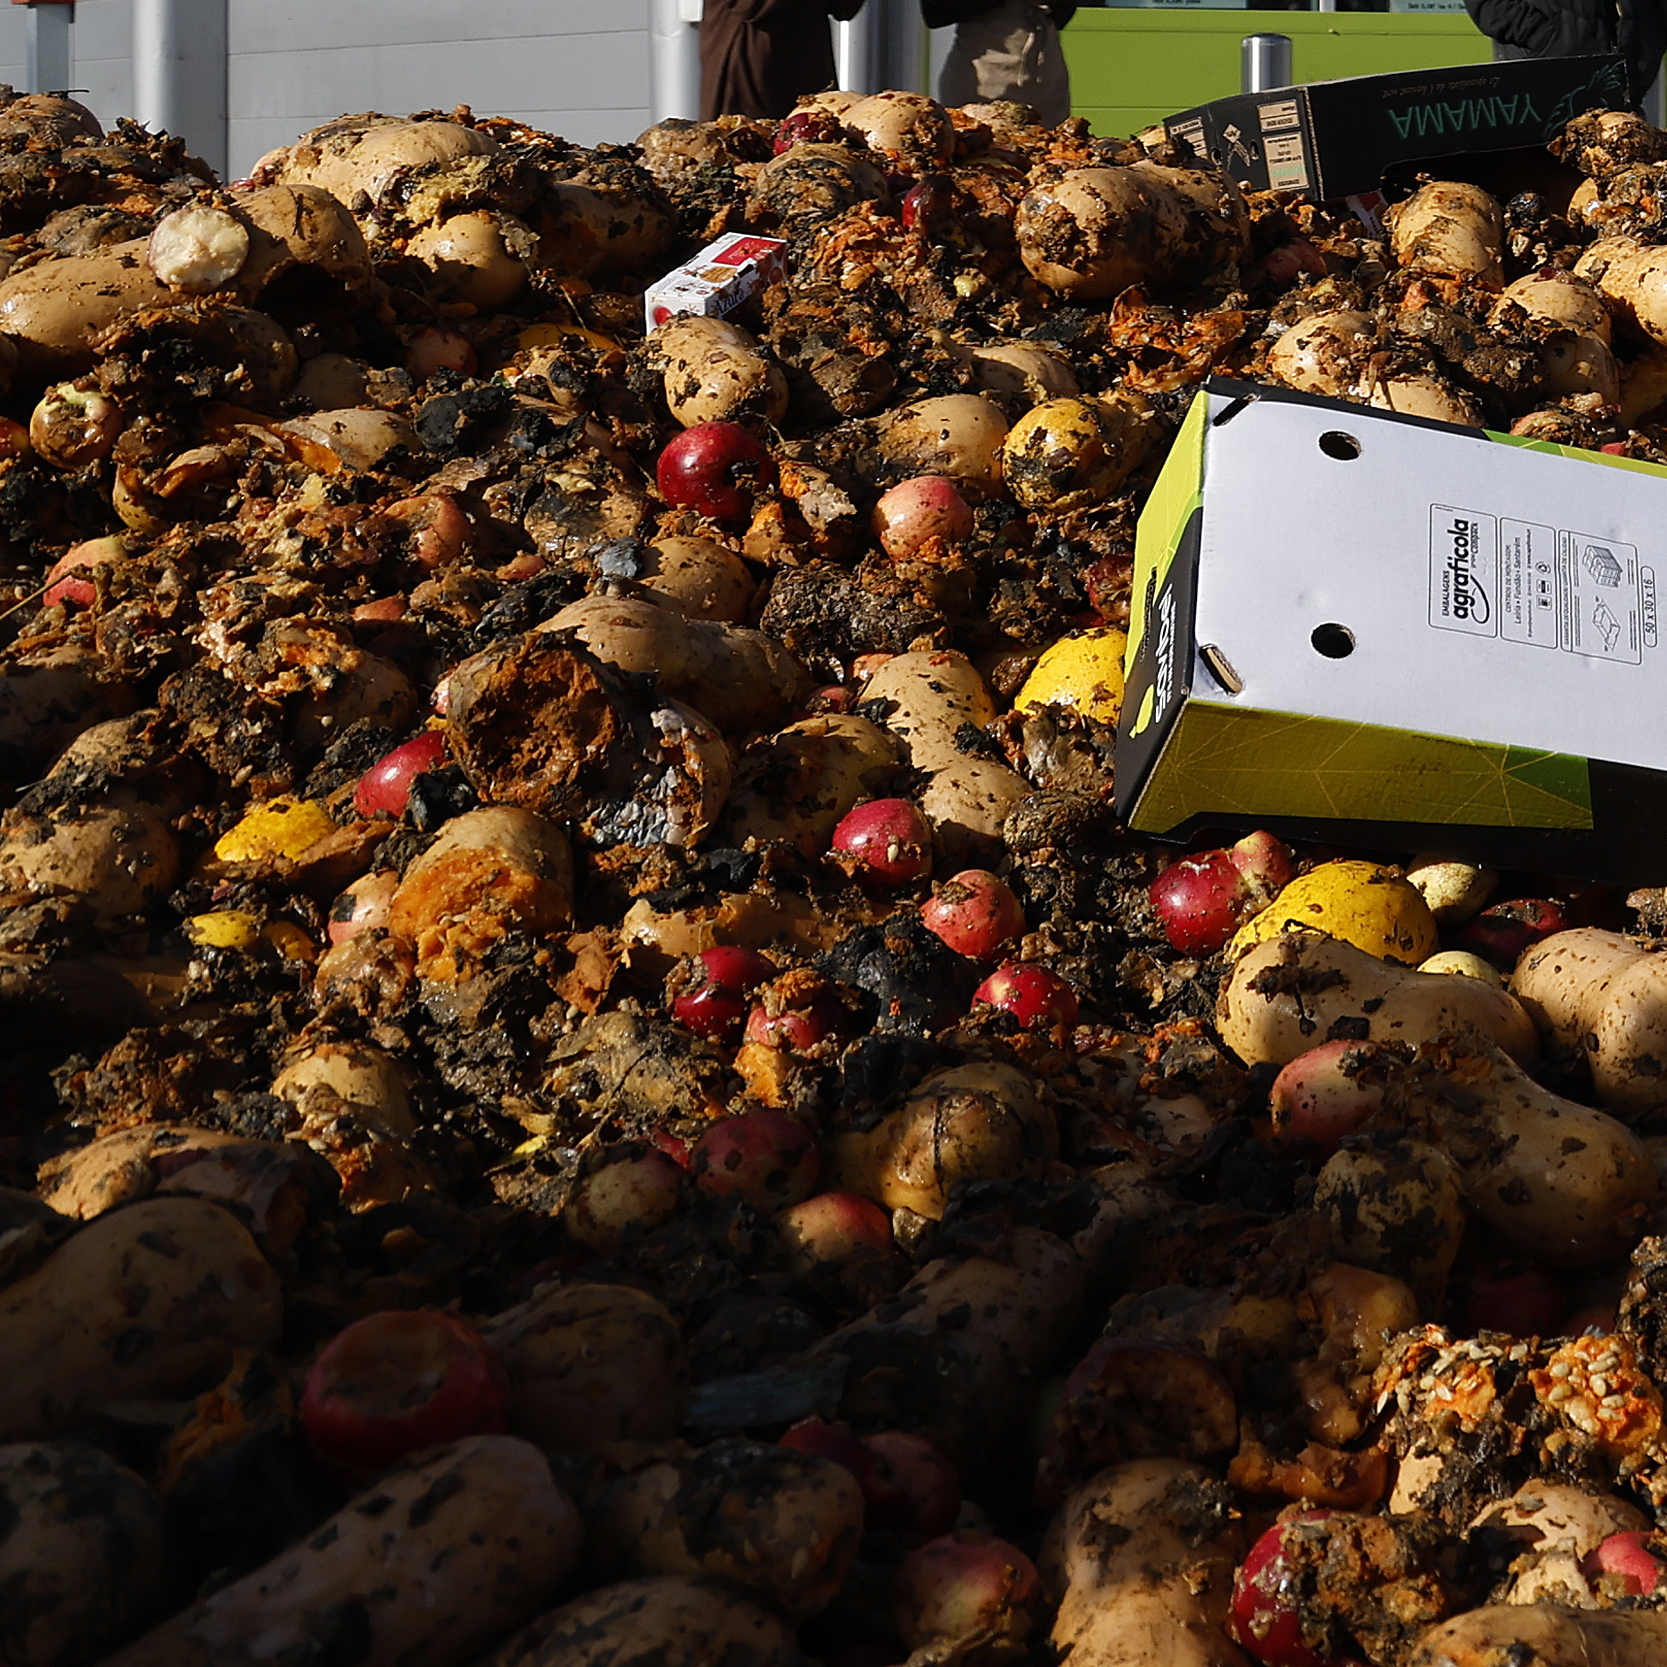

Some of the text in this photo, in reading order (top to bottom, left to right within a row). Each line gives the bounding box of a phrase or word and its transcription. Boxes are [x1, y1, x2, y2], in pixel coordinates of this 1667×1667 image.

[1386, 93, 1541, 139] YAMAMA
[1447, 518, 1475, 619] agraficola
[1643, 579, 1653, 589] 16
[1645, 601, 1654, 612] 30
[1646, 622, 1655, 634] 50
